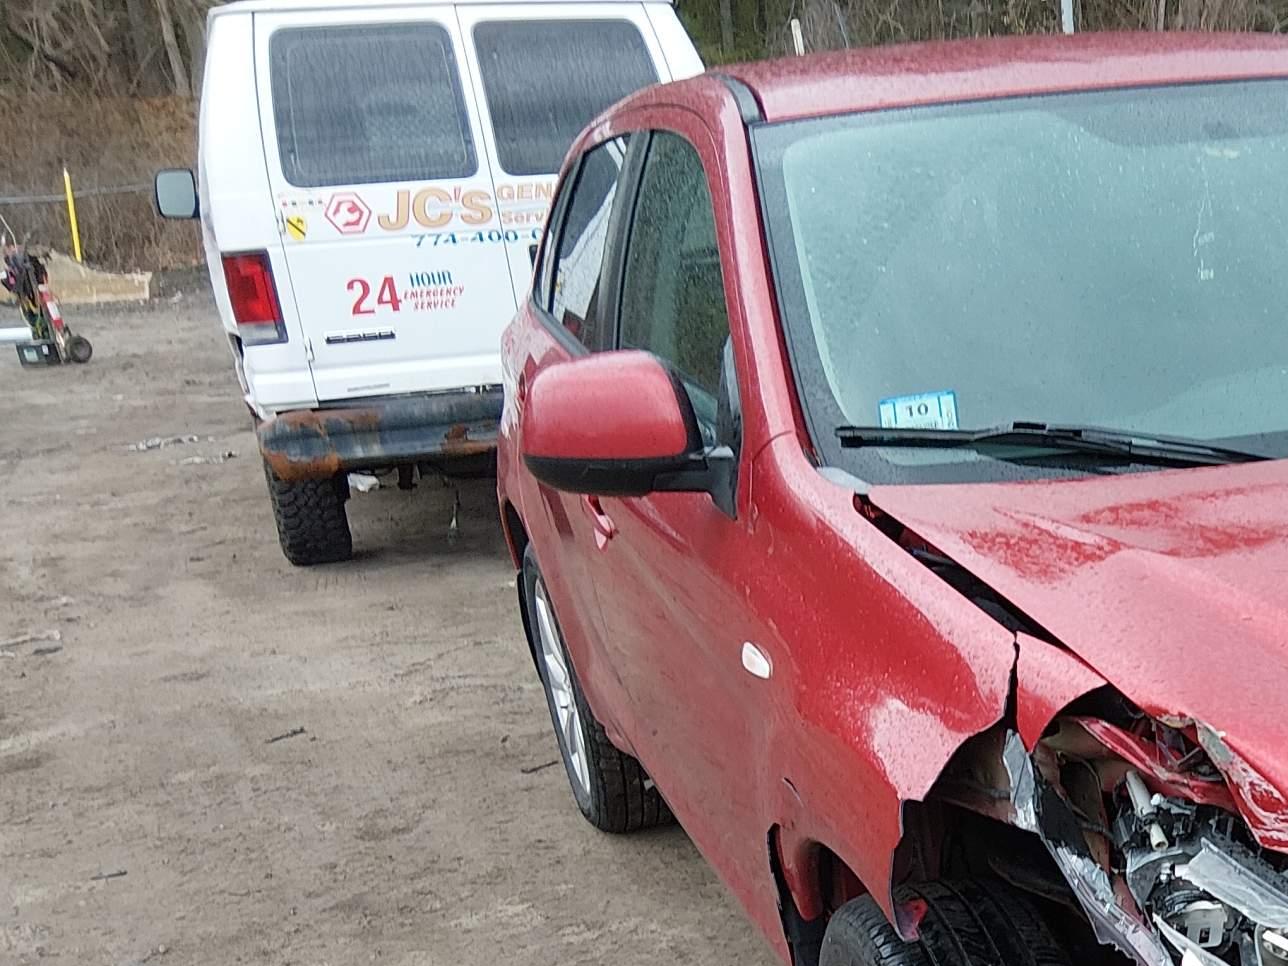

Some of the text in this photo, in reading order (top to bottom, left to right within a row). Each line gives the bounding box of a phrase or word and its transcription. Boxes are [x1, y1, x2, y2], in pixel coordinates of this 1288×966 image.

[346, 270, 453, 315] 24 HOUR
[403, 285, 465, 300] EMERGENCY
[413, 299, 455, 311] SERVICE
[906, 403, 929, 417] 10
